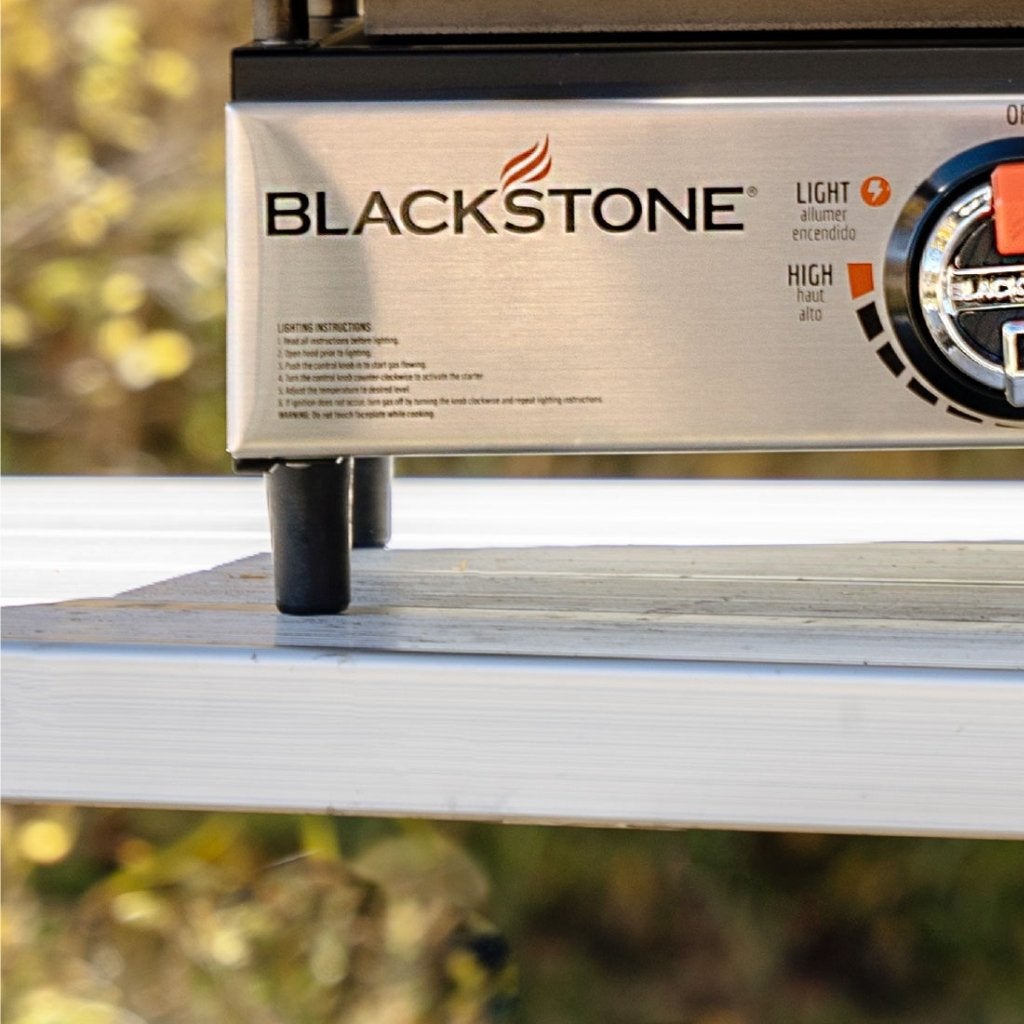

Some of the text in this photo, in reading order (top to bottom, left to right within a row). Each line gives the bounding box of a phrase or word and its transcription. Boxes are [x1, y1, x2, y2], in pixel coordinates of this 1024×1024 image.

[796, 181, 850, 205] LIGHT
[799, 208, 848, 223] allumer
[791, 225, 857, 242] encendido
[787, 263, 834, 287] HIGH
[796, 289, 825, 304] haut
[798, 308, 823, 323] alto
